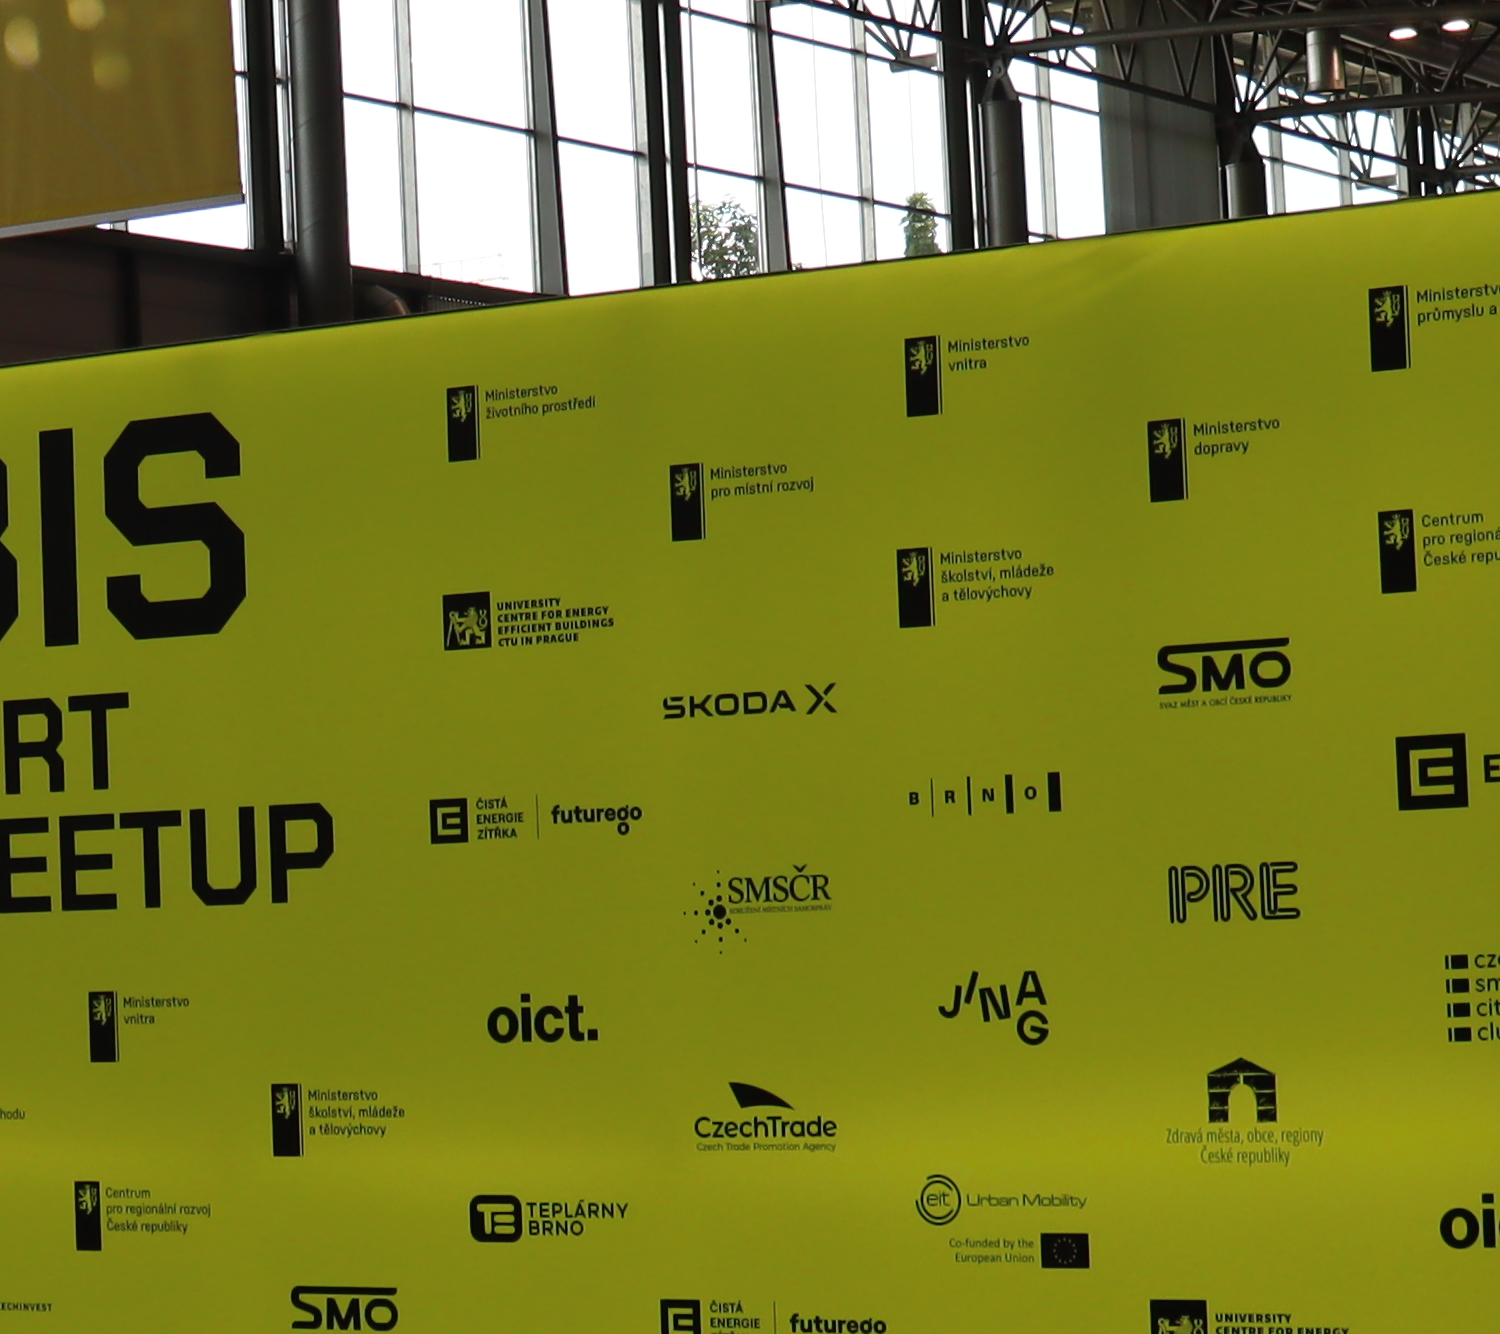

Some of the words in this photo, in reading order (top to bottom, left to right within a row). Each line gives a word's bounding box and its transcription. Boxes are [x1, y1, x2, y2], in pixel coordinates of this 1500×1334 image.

[1417, 303, 1484, 326] průmyslu
[1489, 305, 1497, 315] a
[948, 336, 1029, 353] Ministerstvo
[948, 358, 986, 371] vnitra
[485, 385, 558, 402] Ministerstvo
[486, 402, 538, 419] životního
[542, 395, 595, 416] prostředí
[1193, 418, 1279, 436] Ministerstvo
[1194, 441, 1248, 457] dopravy
[710, 464, 787, 480] Ministerstvo
[711, 487, 731, 501] pro
[734, 480, 773, 495] místní
[777, 476, 814, 492] rozvoj
[1421, 513, 1483, 527] Centrum
[1423, 535, 1445, 549] pro
[940, 548, 1022, 564] Ministerstvo
[1423, 550, 1466, 566] České
[941, 567, 996, 583] školství,
[999, 563, 1054, 579] mládeže
[941, 592, 949, 602] a
[953, 584, 1032, 602] tělovýchovy
[1157, 637, 1291, 695] SMO
[805, 682, 836, 714] X
[551, 804, 642, 835] futurego
[728, 864, 831, 904] SMSČR
[1168, 861, 1301, 923] PRE
[487, 993, 598, 1043] oict.
[694, 1115, 836, 1138] CzechTrade
[526, 1199, 628, 1218] TEPLÁRNY
[966, 1193, 1019, 1206] Urban
[1022, 1194, 1087, 1209] Mobility
[528, 1220, 584, 1236] BRNO
[290, 1285, 398, 1331] SMO
[709, 1300, 743, 1313] ČISTÁ
[710, 1317, 760, 1329] ENERGIE
[1215, 1313, 1291, 1324] UNIVERSITY
